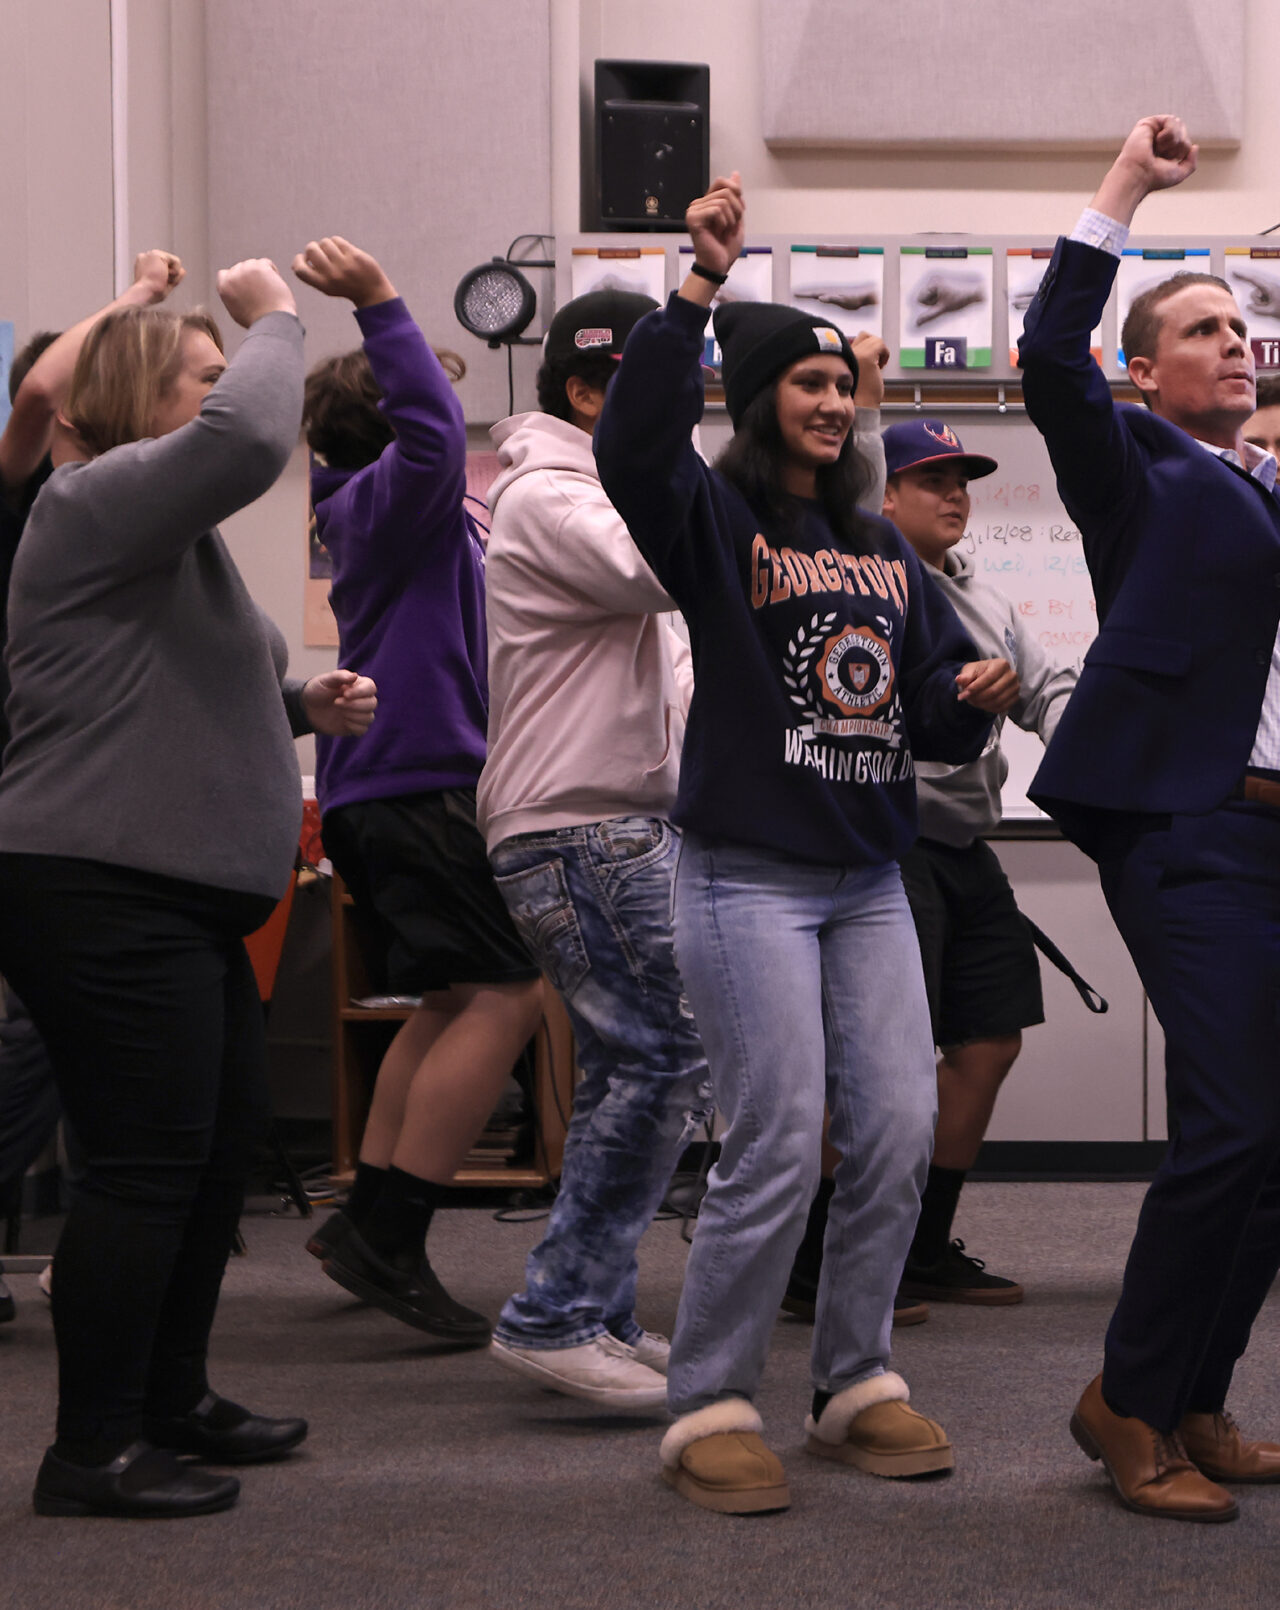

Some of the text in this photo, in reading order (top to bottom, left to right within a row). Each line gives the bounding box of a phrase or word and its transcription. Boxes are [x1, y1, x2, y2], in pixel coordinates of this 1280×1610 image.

[934, 341, 956, 364] Fa
[1261, 341, 1280, 364] Ti
[833, 687, 882, 707] ATHLETIC
[819, 720, 890, 737] CHAMPIONSHIP
